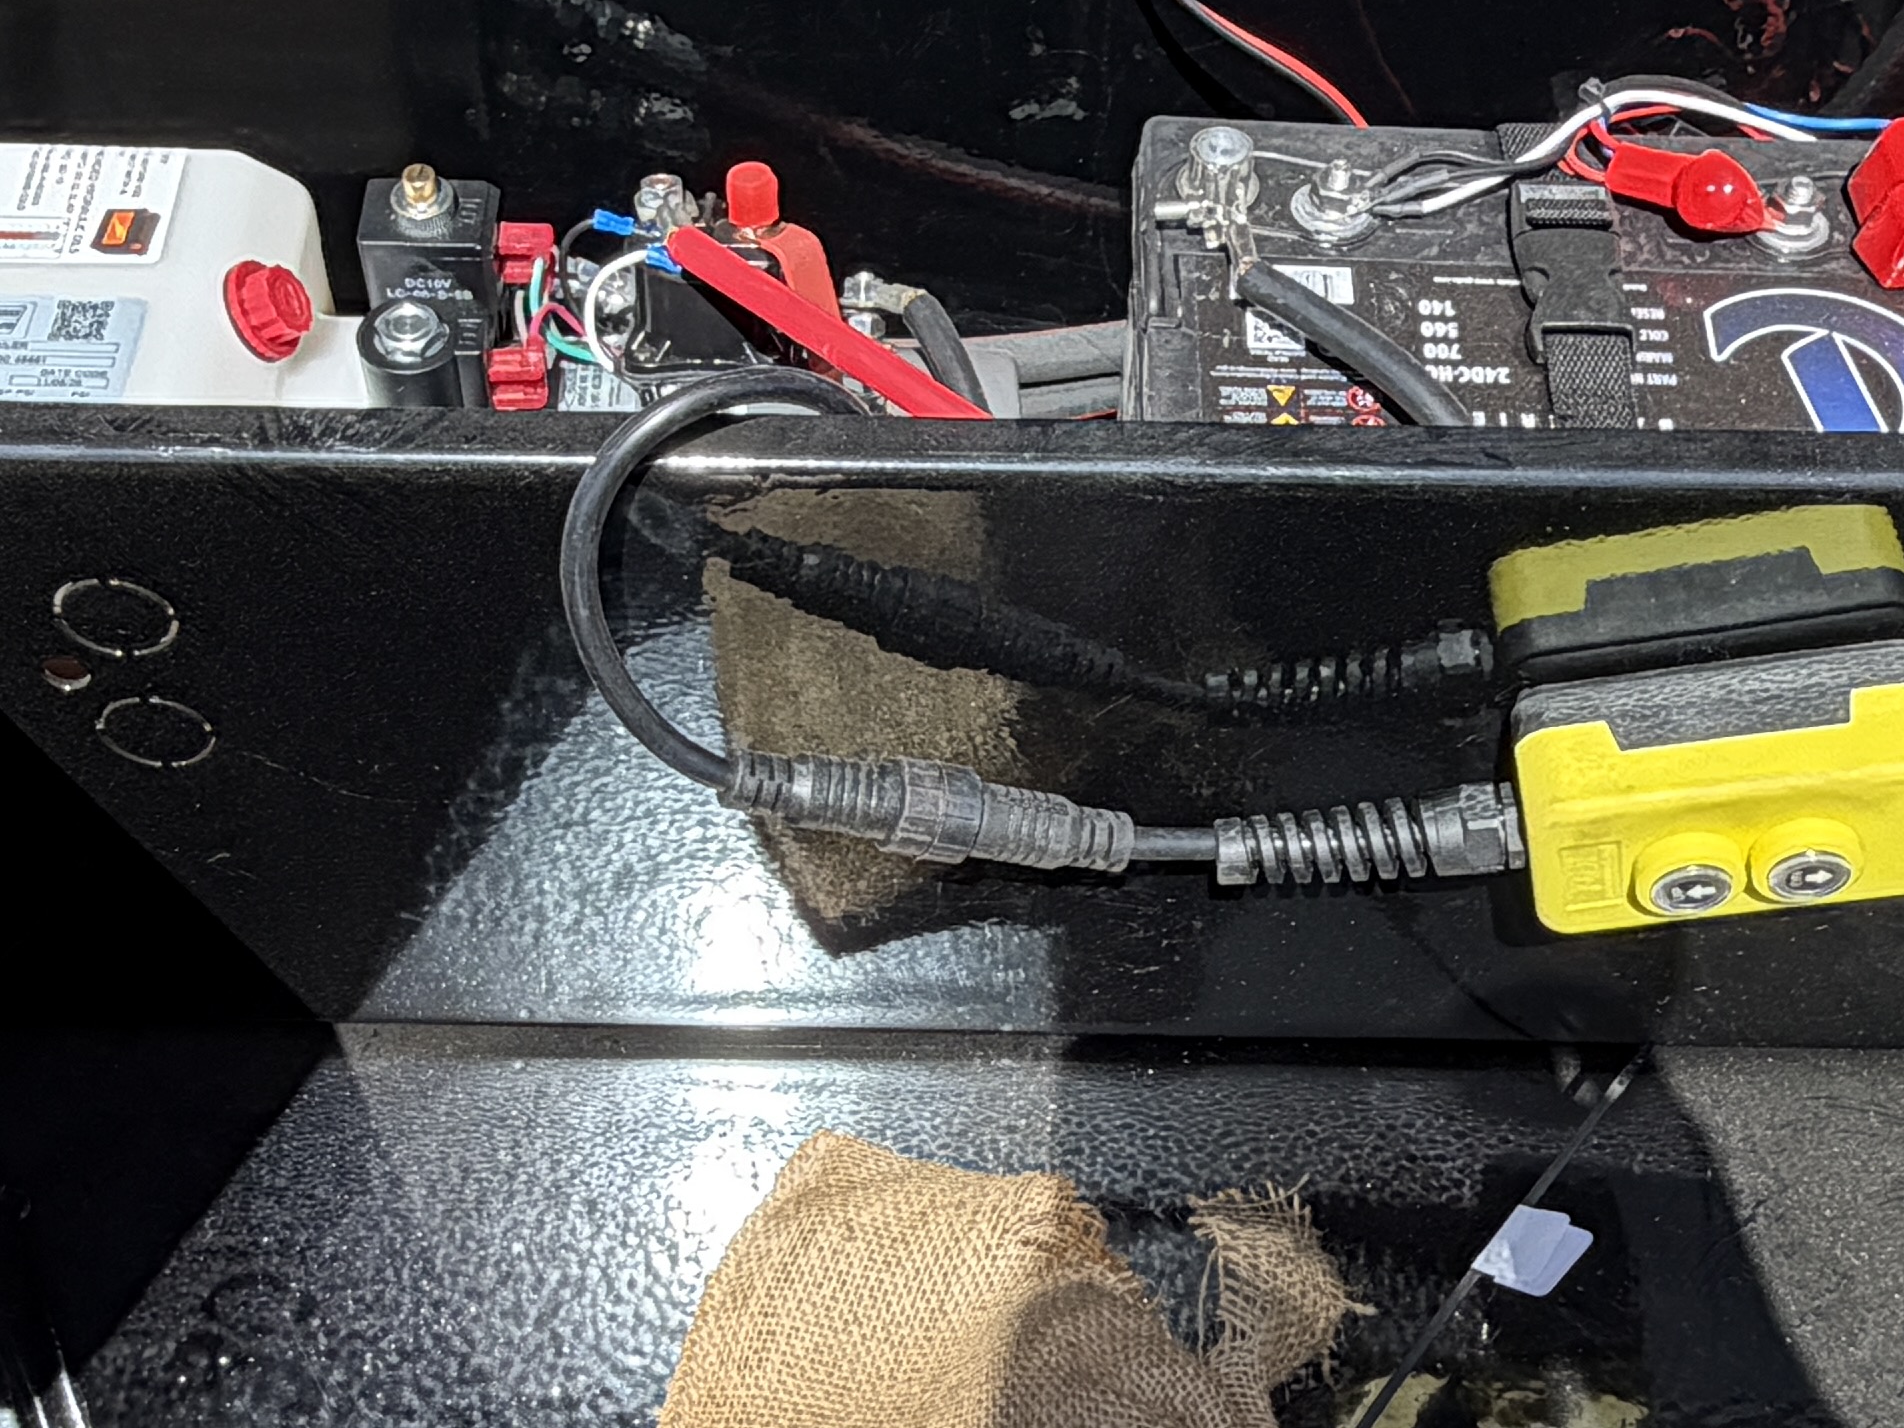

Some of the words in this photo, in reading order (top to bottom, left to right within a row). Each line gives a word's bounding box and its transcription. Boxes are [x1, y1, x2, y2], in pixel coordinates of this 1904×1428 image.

[1418, 299, 1456, 317] 140
[1420, 321, 1459, 339] 560
[1423, 342, 1462, 360] 700
